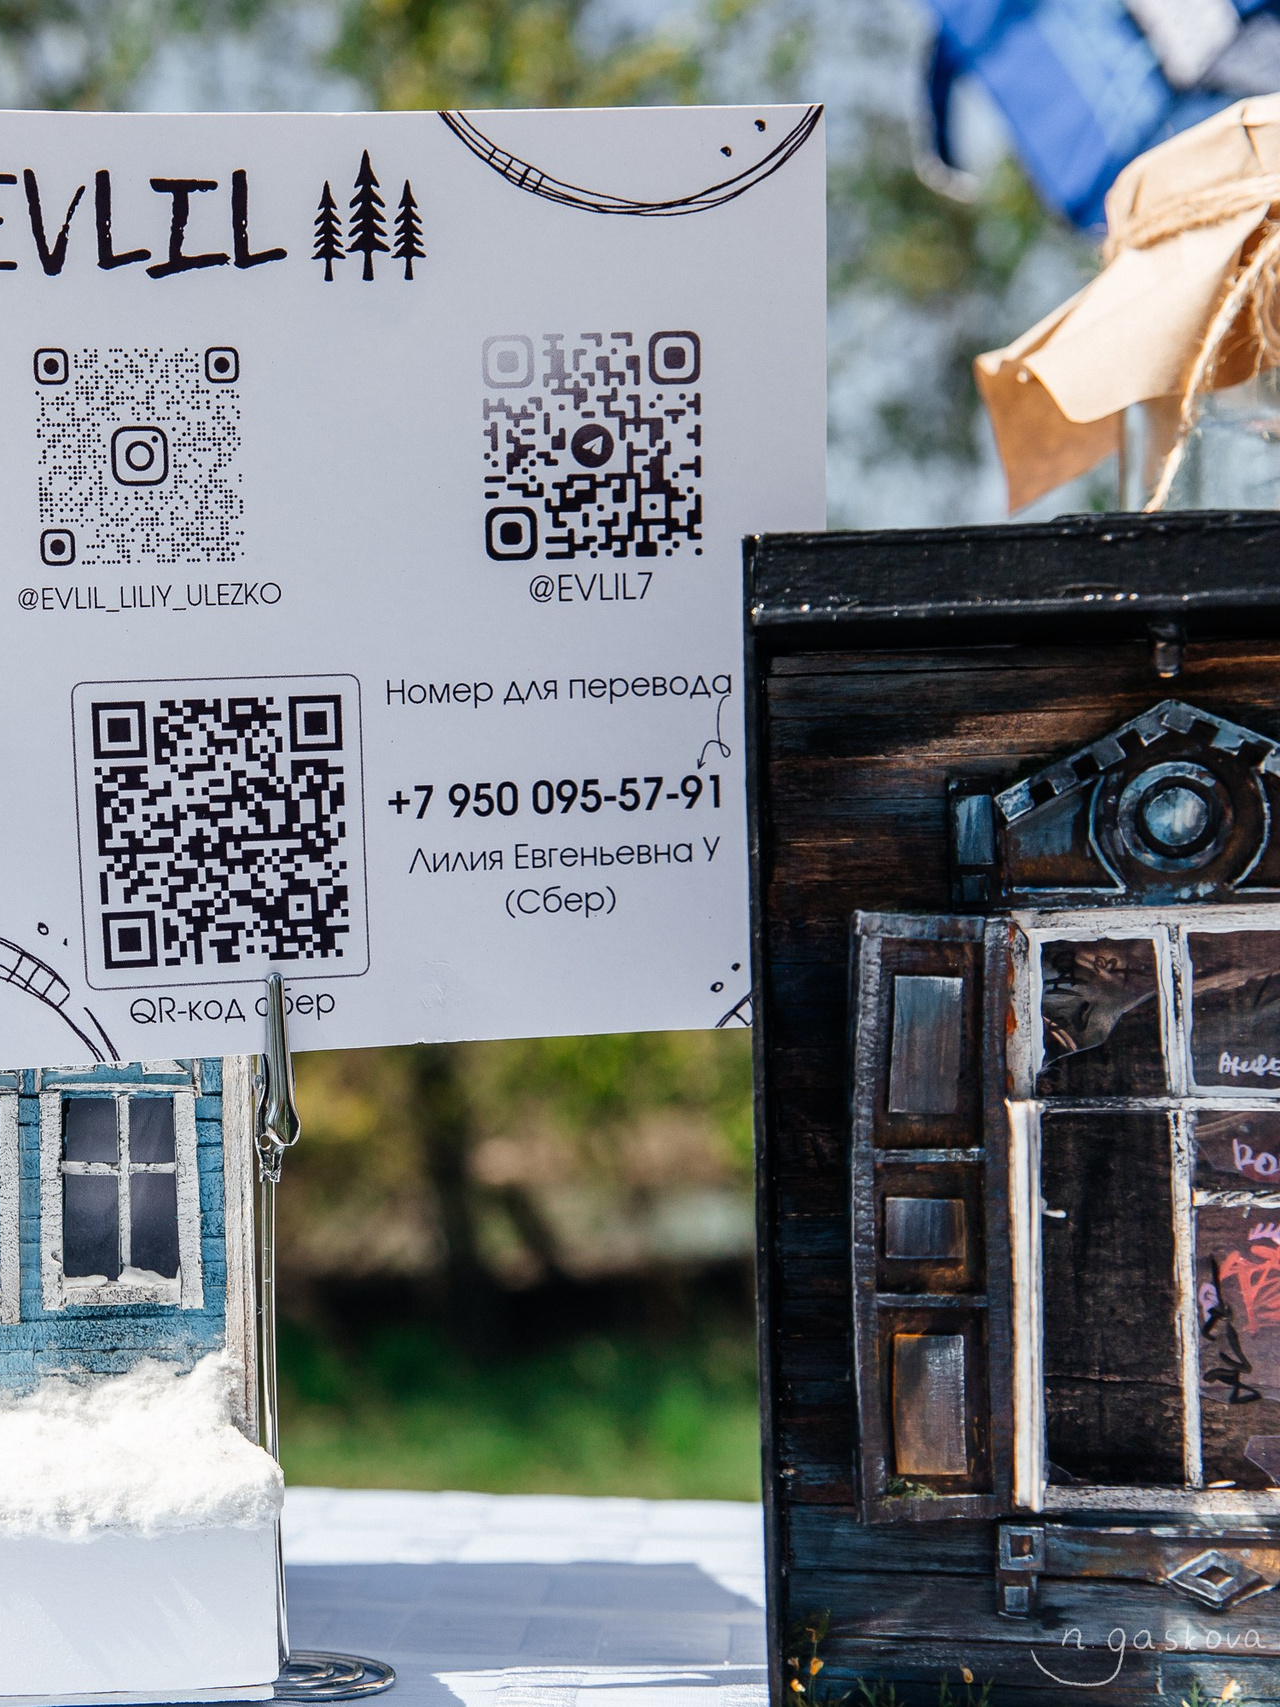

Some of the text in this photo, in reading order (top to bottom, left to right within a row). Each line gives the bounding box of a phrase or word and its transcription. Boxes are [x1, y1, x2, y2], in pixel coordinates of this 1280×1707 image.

[18, 583, 281, 612] @EVLIL_LILIY_ULEZKO
[530, 572, 653, 603] @EVLIL7
[387, 674, 732, 708] Номер для перевода
[388, 775, 720, 819] +7 950 095-57-91
[409, 848, 503, 873] Лилия
[515, 843, 692, 869] Евгеньевна
[506, 886, 616, 918] (Сбер)
[130, 997, 245, 1024] QR-код
